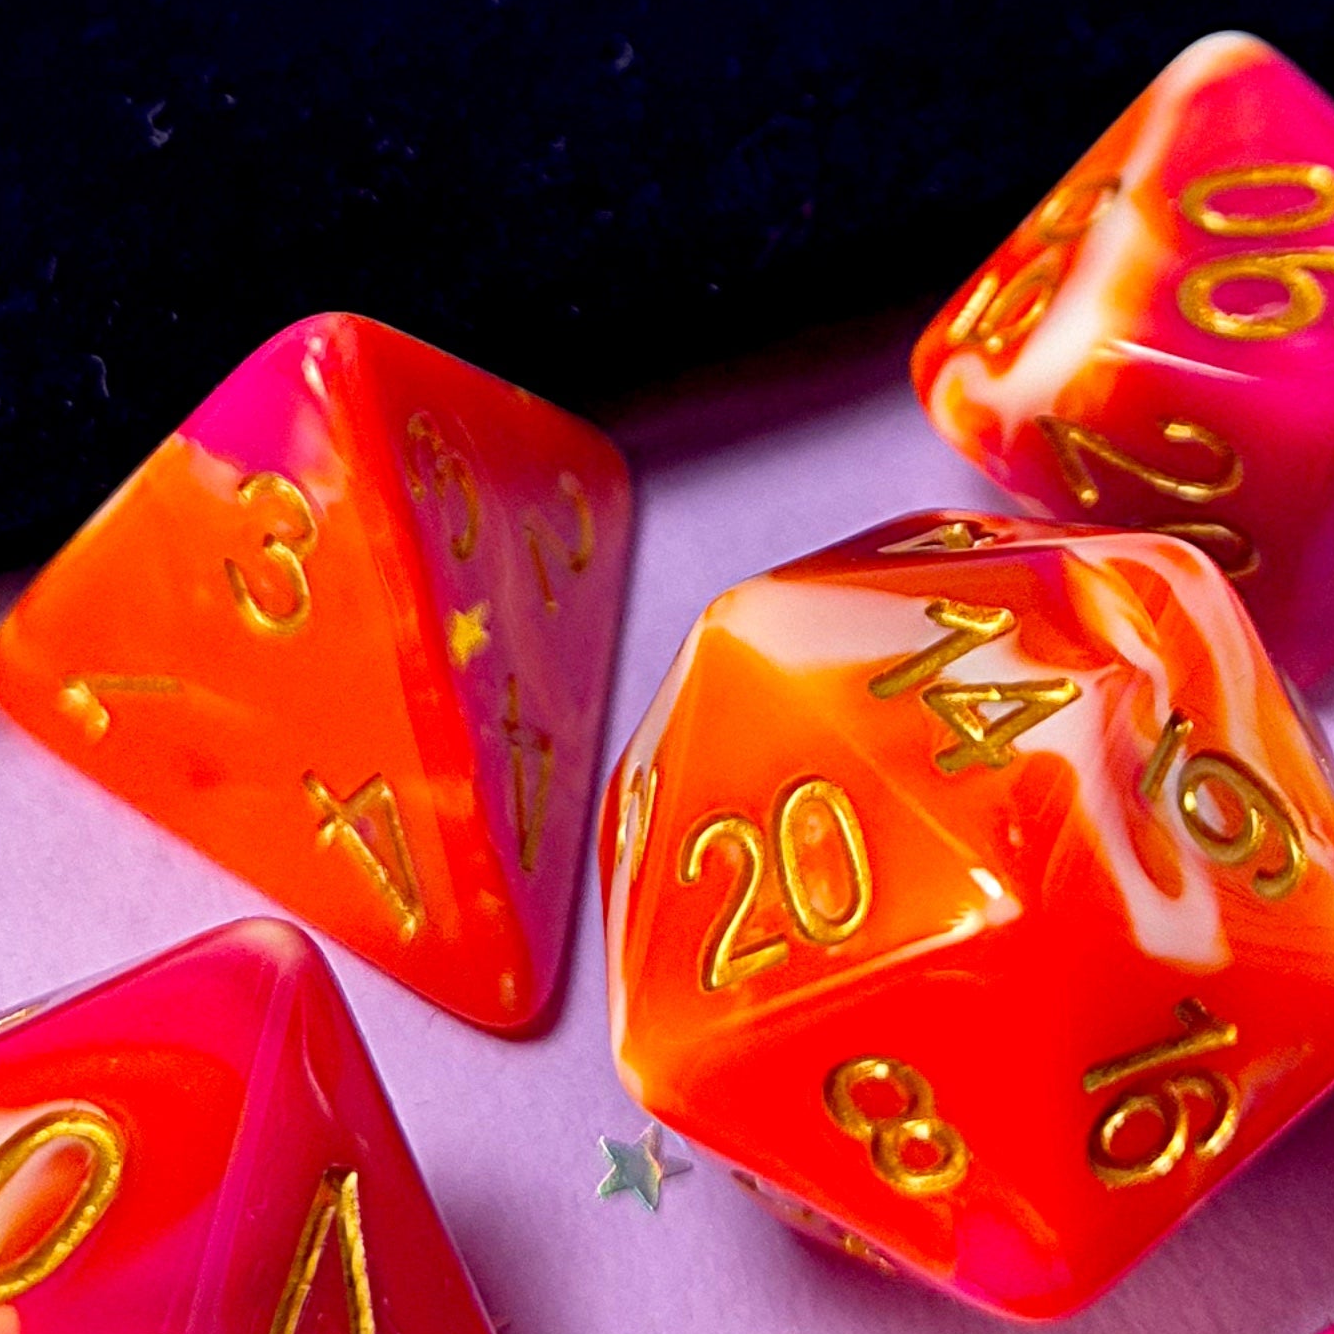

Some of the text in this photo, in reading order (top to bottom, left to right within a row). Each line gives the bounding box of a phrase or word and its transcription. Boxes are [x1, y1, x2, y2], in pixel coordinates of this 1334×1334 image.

[223, 469, 319, 637] 3
[869, 597, 1081, 773] 14
[301, 767, 421, 945] 4
[679, 773, 871, 991] 20
[823, 1059, 971, 1195] 8
[1083, 995, 1239, 1191] 16
